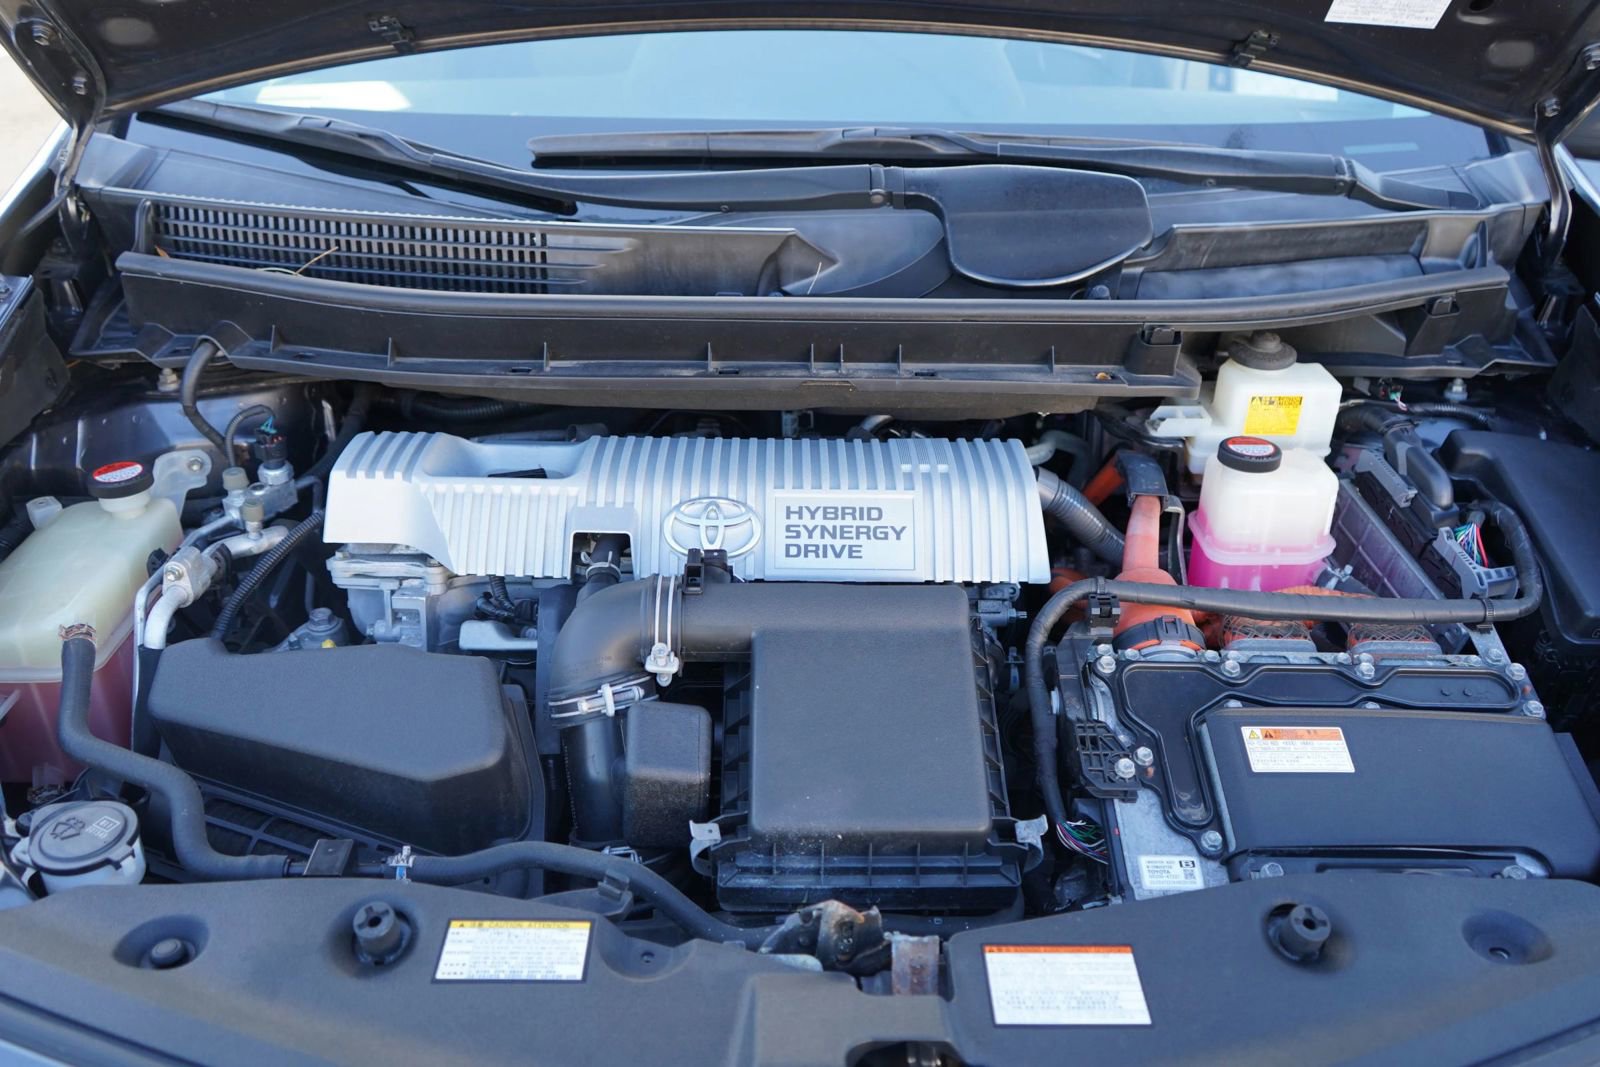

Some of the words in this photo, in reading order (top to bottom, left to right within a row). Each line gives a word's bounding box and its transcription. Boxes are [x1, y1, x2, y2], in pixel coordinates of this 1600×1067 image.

[785, 505, 883, 521] HYBRID
[785, 524, 907, 540] SYNERGY
[785, 543, 863, 559] DRIVE
